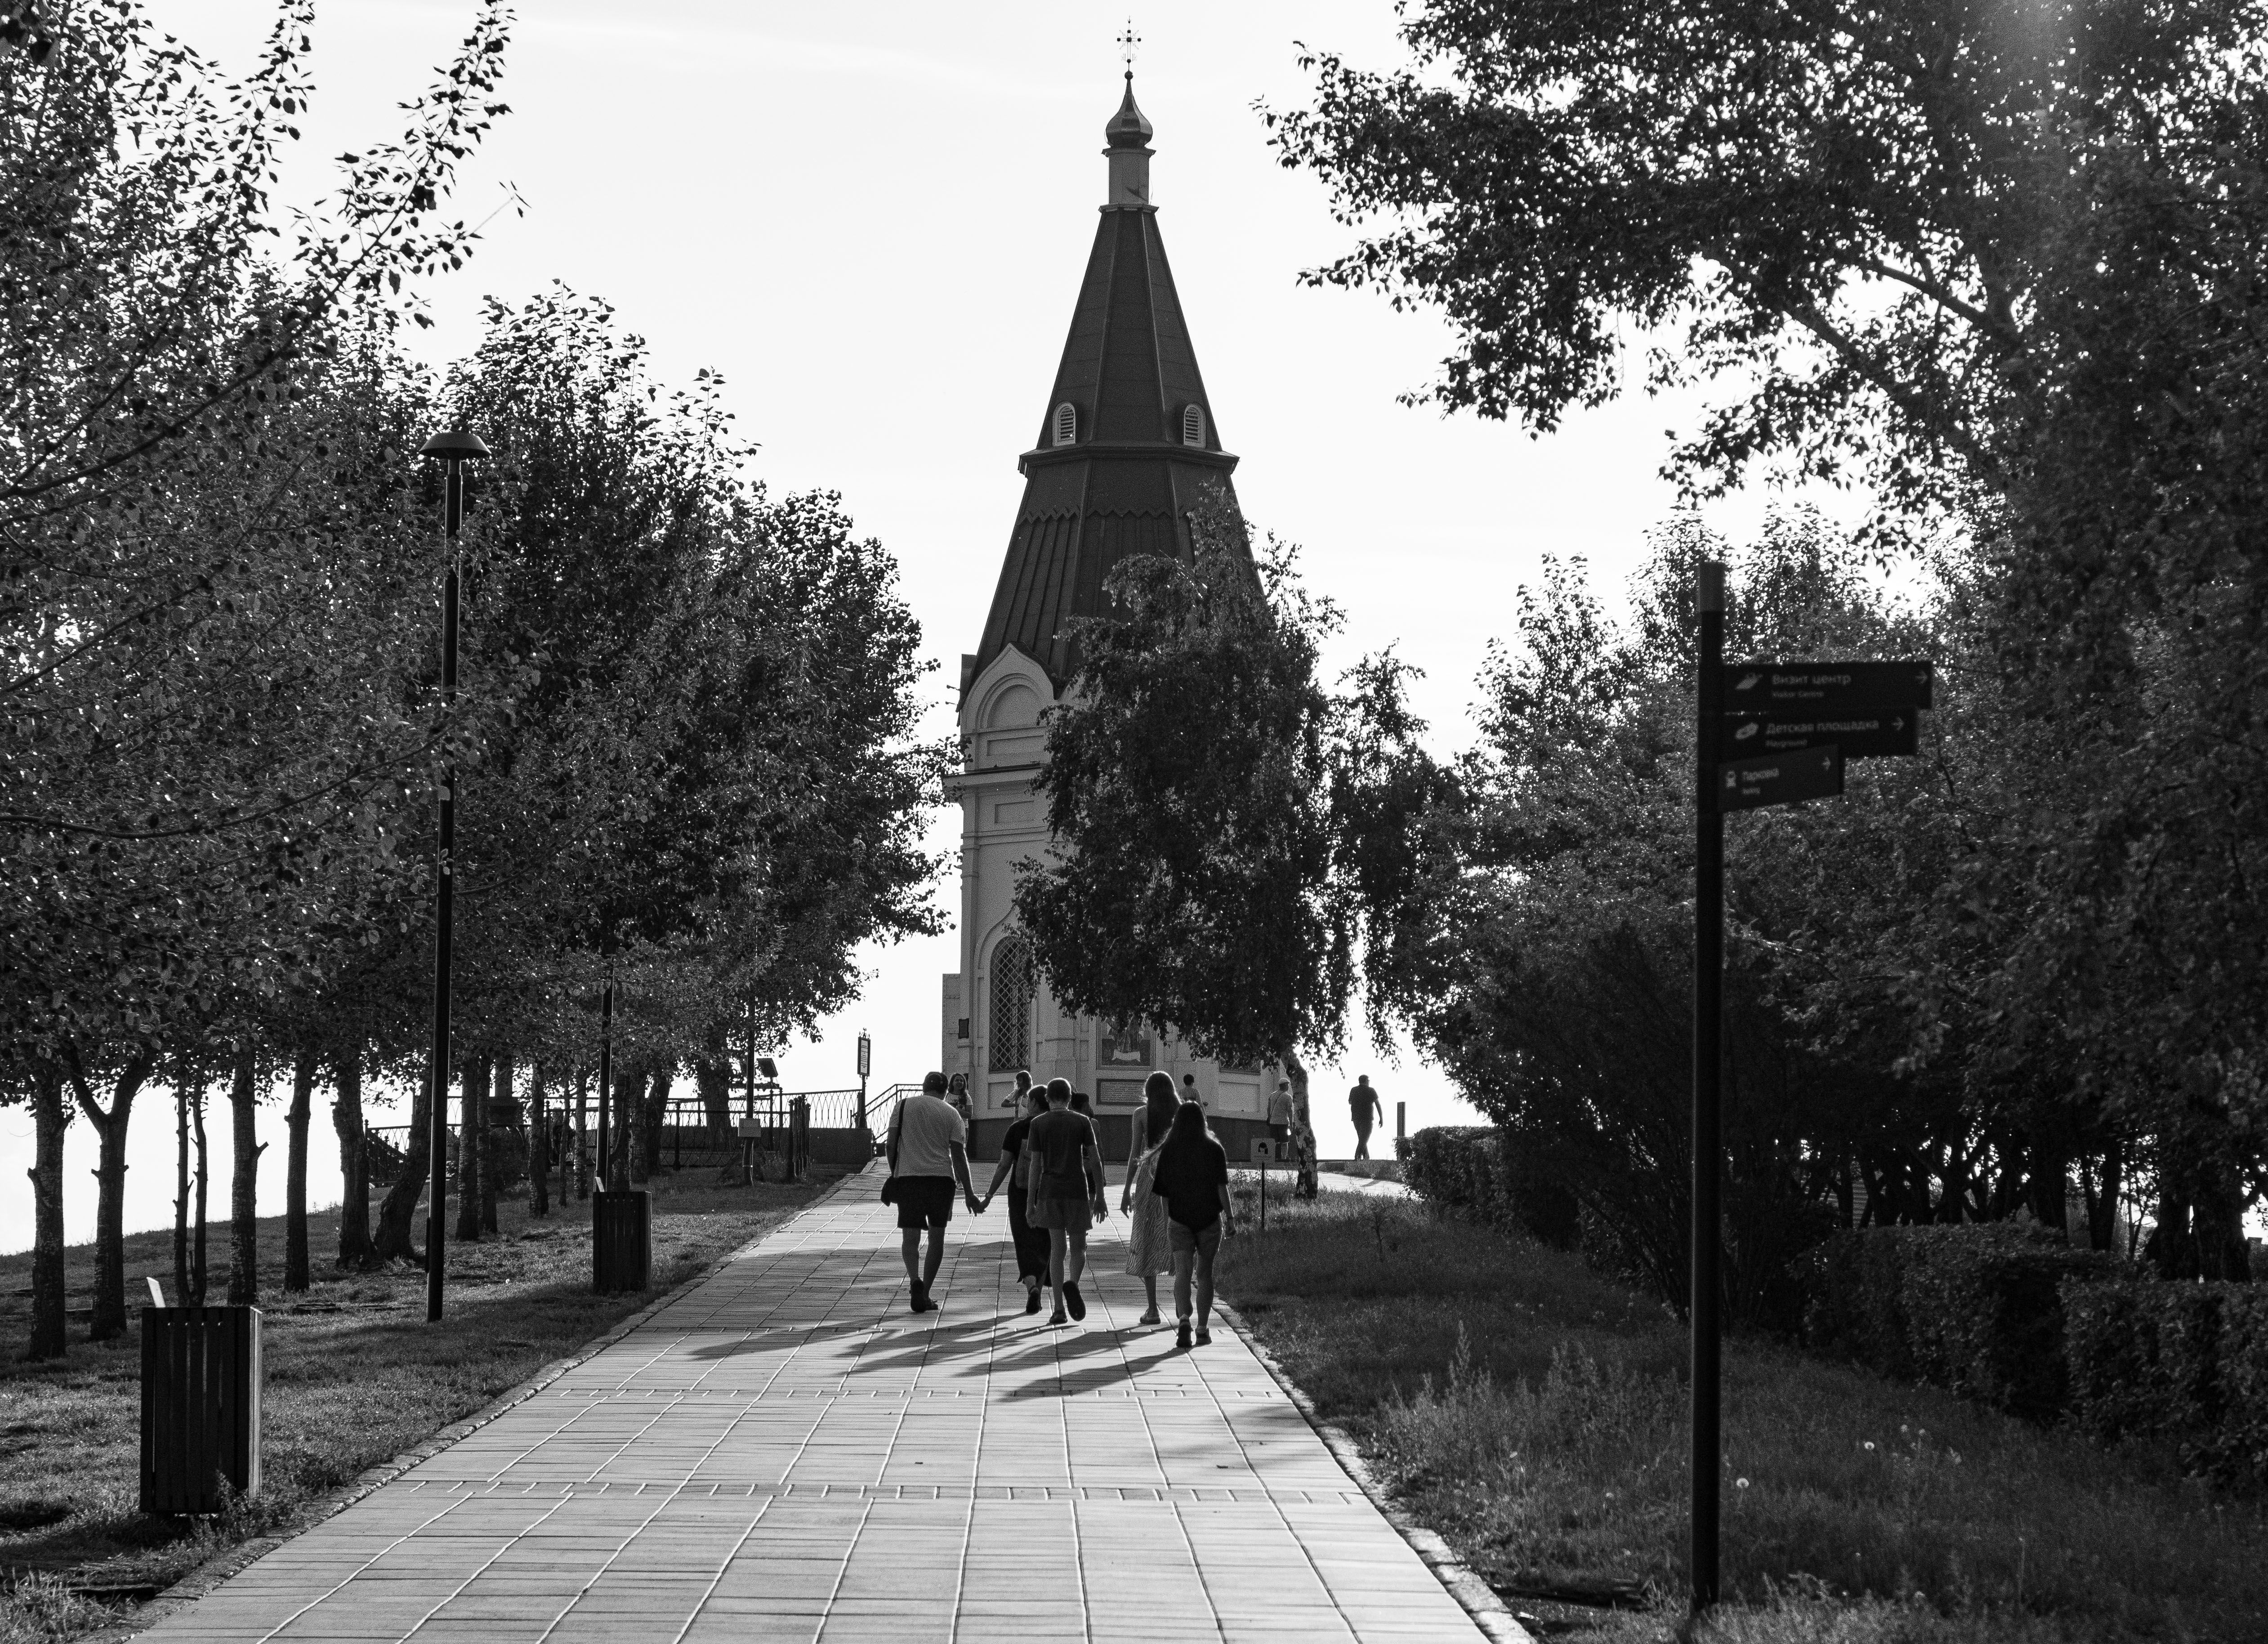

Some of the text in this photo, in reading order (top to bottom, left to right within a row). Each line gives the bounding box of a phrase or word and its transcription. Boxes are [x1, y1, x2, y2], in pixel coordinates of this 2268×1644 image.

[1772, 674, 1852, 686] Визит центр
[1766, 720, 1880, 734] Детская площадка
